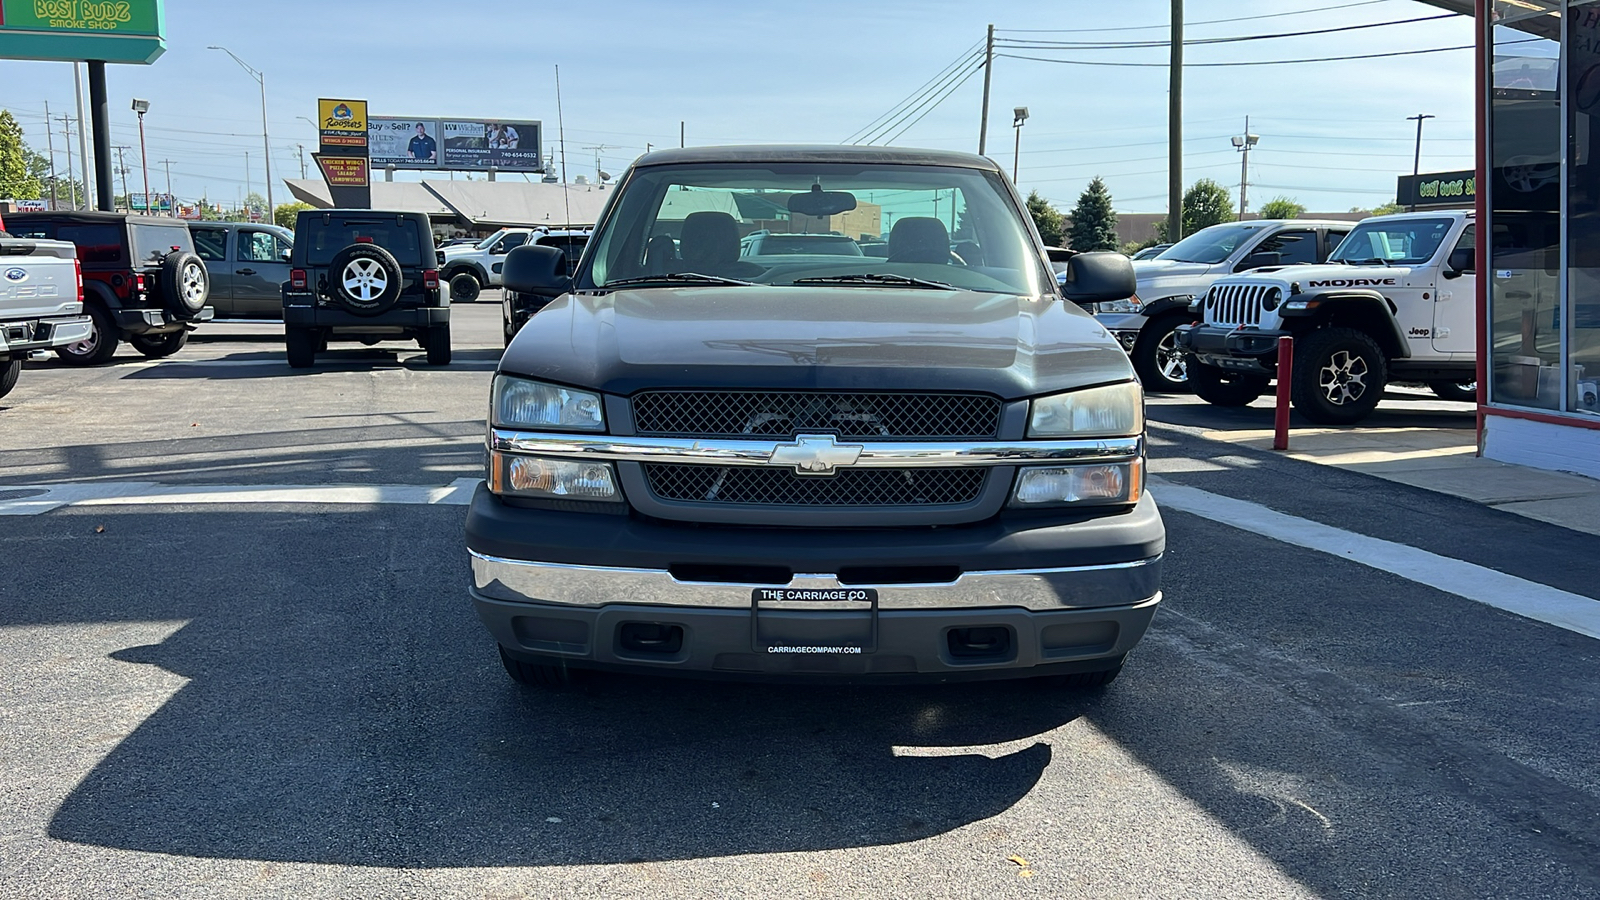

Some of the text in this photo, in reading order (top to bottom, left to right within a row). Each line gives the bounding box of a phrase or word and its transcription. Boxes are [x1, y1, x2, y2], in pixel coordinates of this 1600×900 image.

[80, 0, 131, 22] BUDZ
[49, 20, 117, 29] SMOKE SHOP
[324, 117, 362, 128] Roosters
[368, 123, 382, 131] Buy
[1440, 180, 1464, 197] BUDZ
[1309, 279, 1396, 287] MOJAVE
[1408, 326, 1430, 337] Jeep
[760, 589, 869, 601] THE CARRIAGE CO.
[767, 646, 862, 654] CARRIAGECOMPANY.COM
